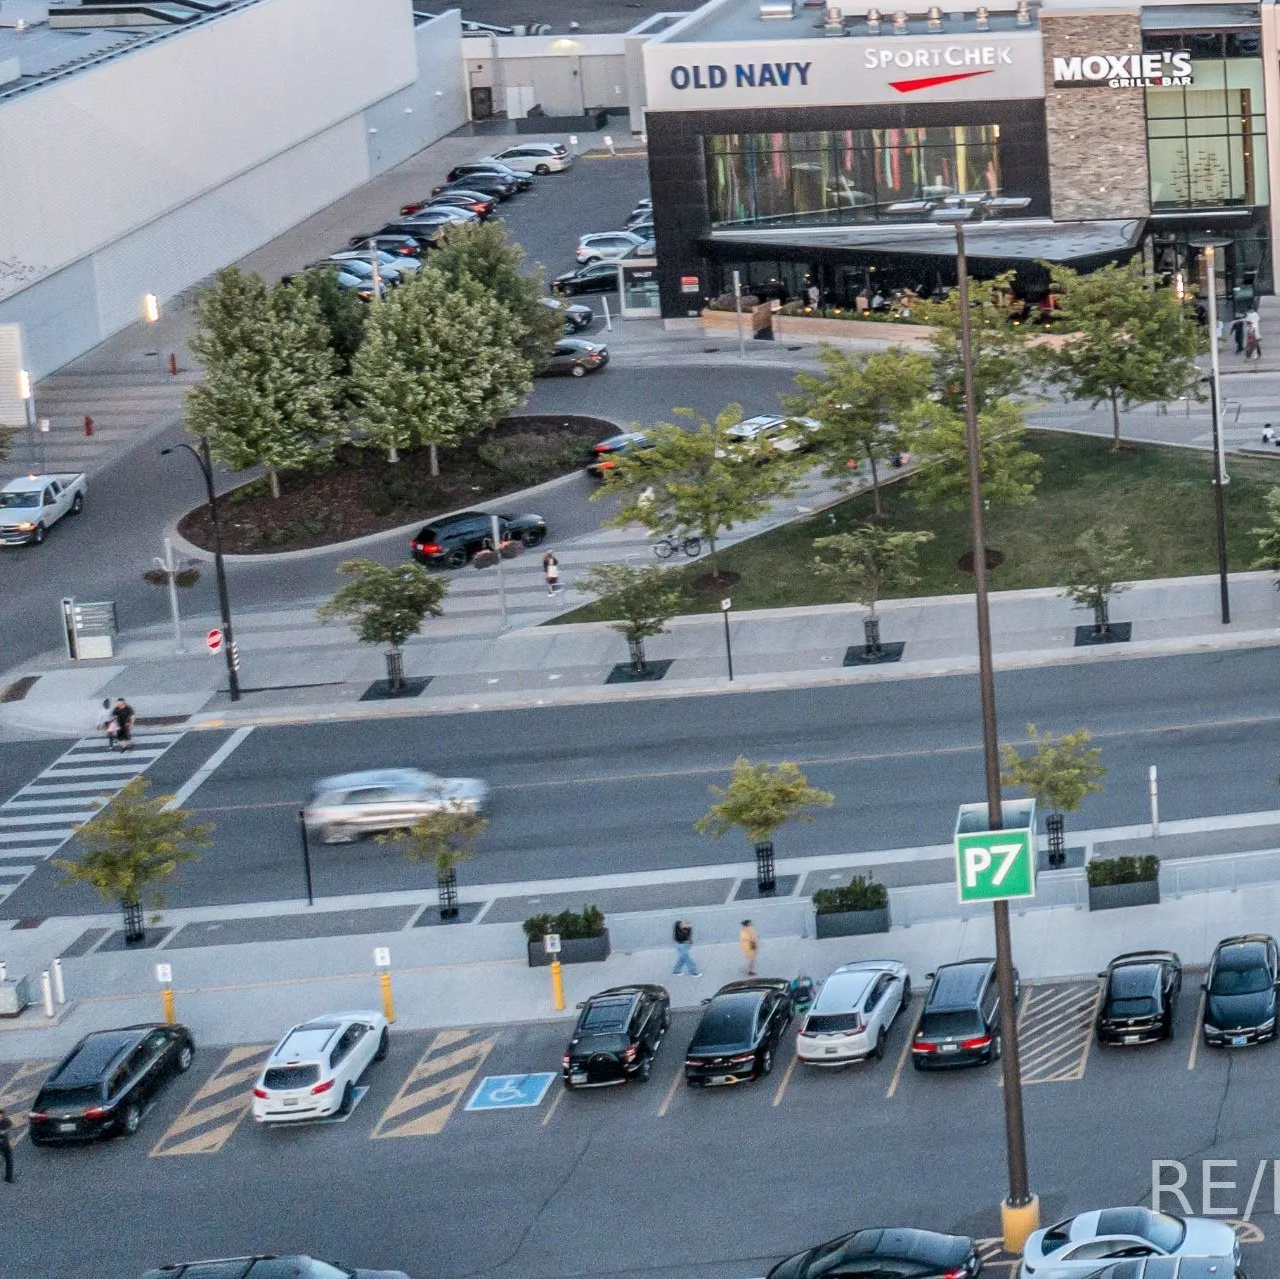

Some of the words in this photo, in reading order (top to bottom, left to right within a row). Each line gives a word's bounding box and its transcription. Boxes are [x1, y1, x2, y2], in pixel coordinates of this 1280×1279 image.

[670, 64, 728, 90] OLD
[735, 61, 813, 88] NAVY
[1052, 51, 1193, 81] MOXIE'S
[1108, 77, 1155, 89] GRILL
[1161, 76, 1193, 87] BAR
[965, 843, 1023, 888] P7
